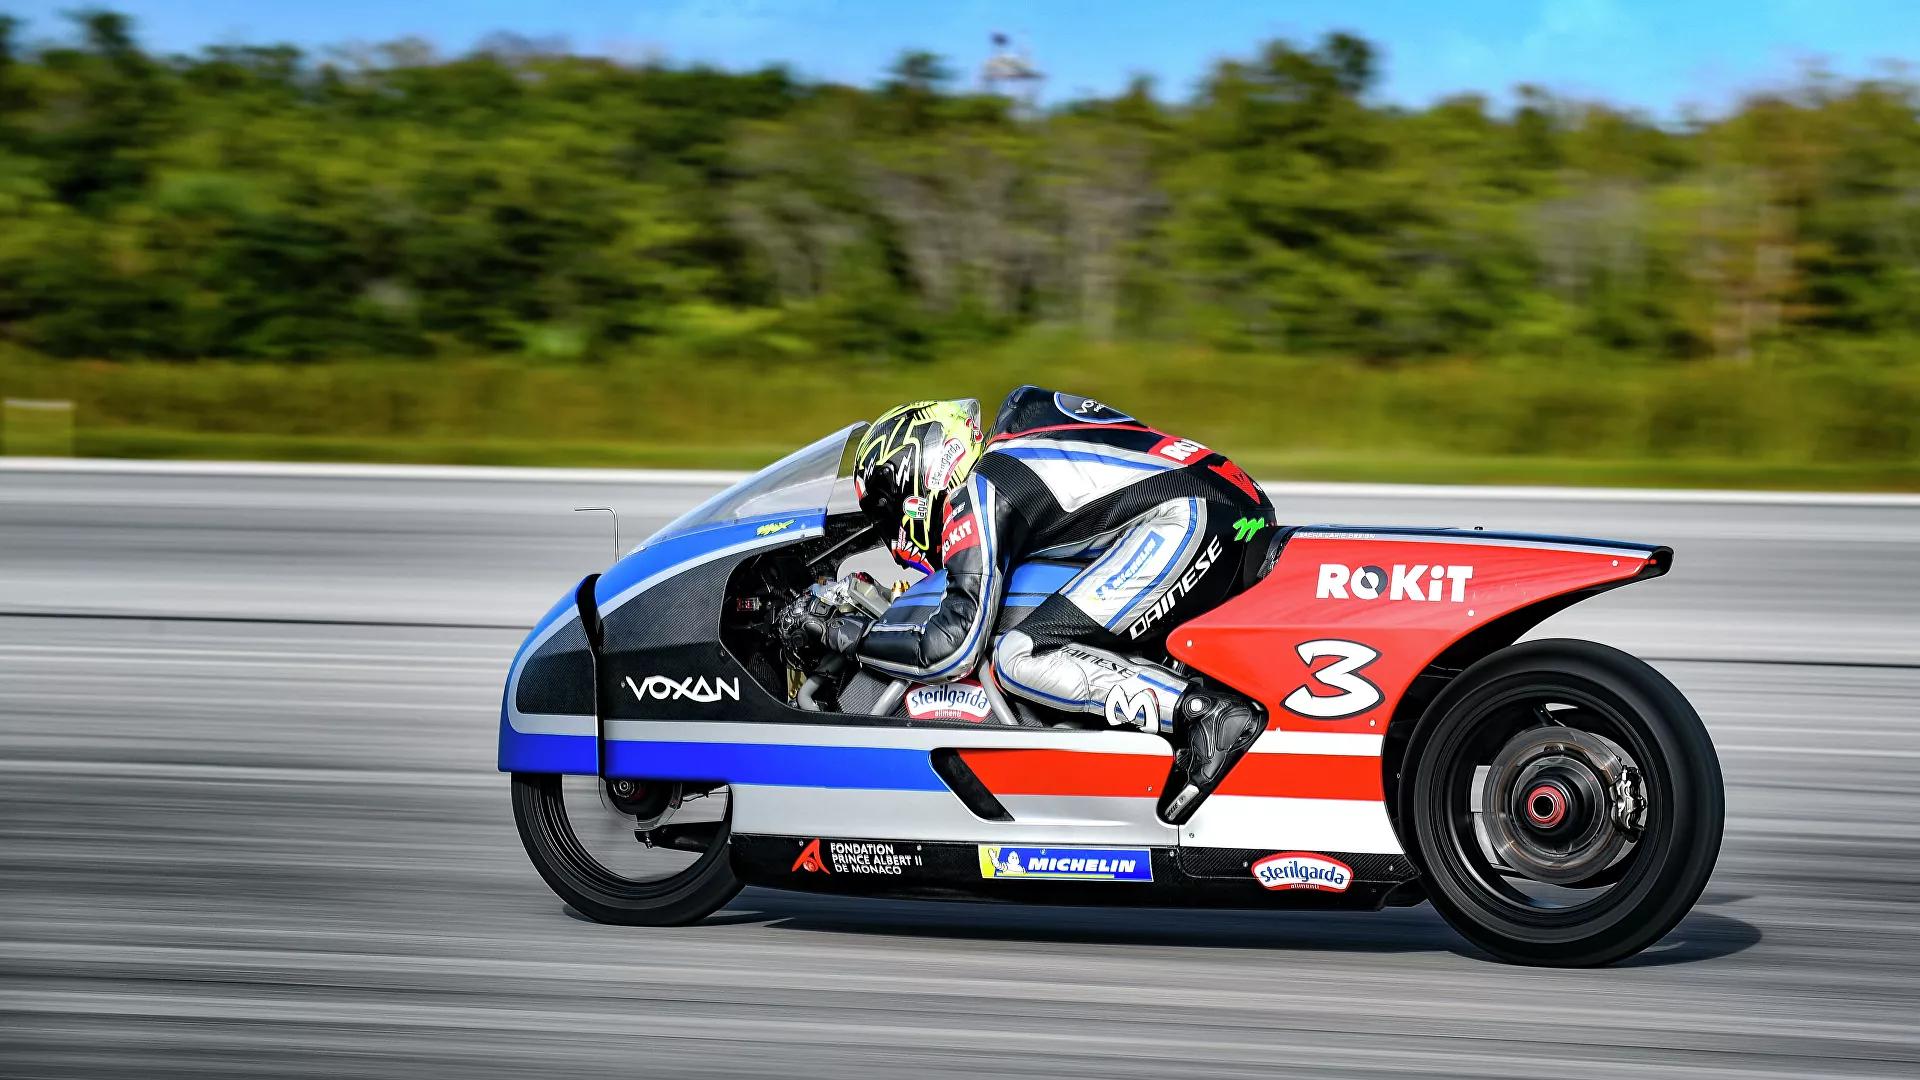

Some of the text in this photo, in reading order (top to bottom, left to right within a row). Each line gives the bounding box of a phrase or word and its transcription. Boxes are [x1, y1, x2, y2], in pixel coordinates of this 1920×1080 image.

[1129, 534, 1223, 640] DAINESE
[625, 675, 740, 702] VOXAN
[1279, 638, 1386, 721] 3
[911, 684, 988, 710] sterilgarda
[830, 842, 895, 855] FONDATION
[831, 853, 871, 865] PRINCE
[873, 854, 912, 866] ALBERT
[834, 863, 902, 875] DE MONACO
[1028, 857, 1137, 873] MICHELIN
[1260, 860, 1345, 885] sterilgarda
